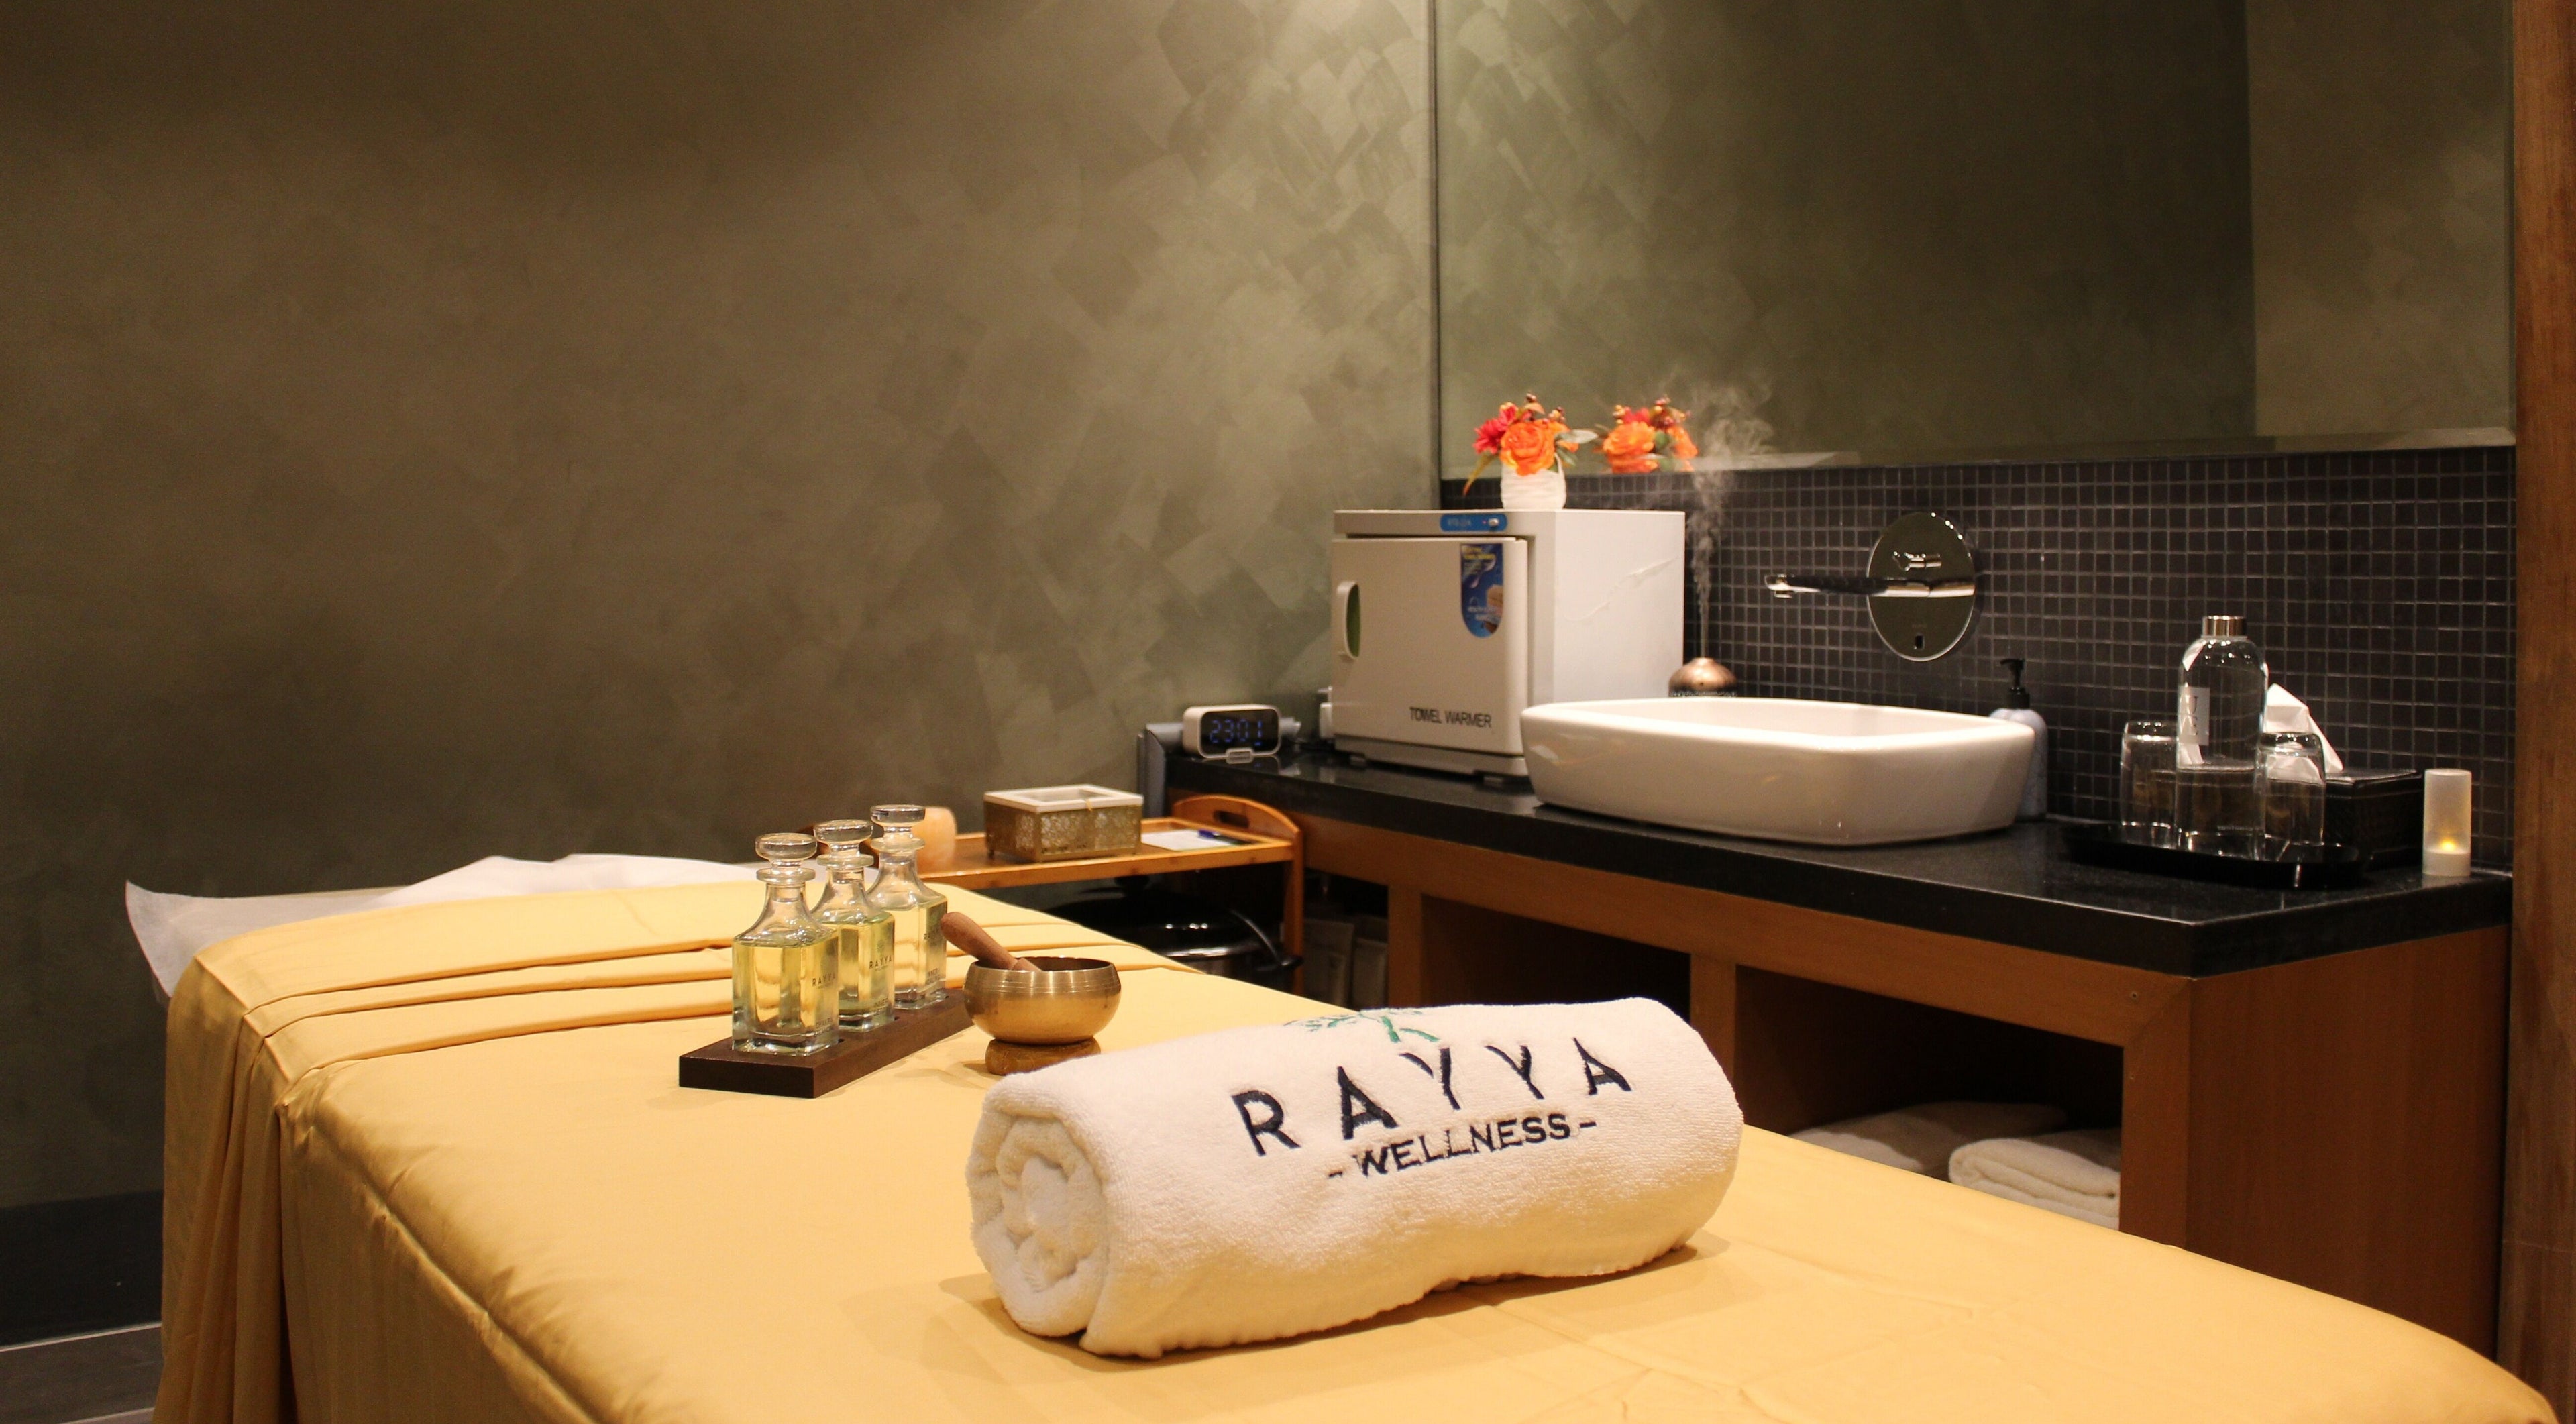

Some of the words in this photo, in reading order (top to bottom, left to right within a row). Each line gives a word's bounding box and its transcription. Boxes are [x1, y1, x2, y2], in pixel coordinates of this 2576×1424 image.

[1409, 706, 1442, 724] TOWEL
[1444, 710, 1492, 728] WARMER
[869, 955, 892, 969] RAYYA
[1231, 1037, 1631, 1156] RAYYA
[1352, 1113, 1571, 1176] WELLNESS
